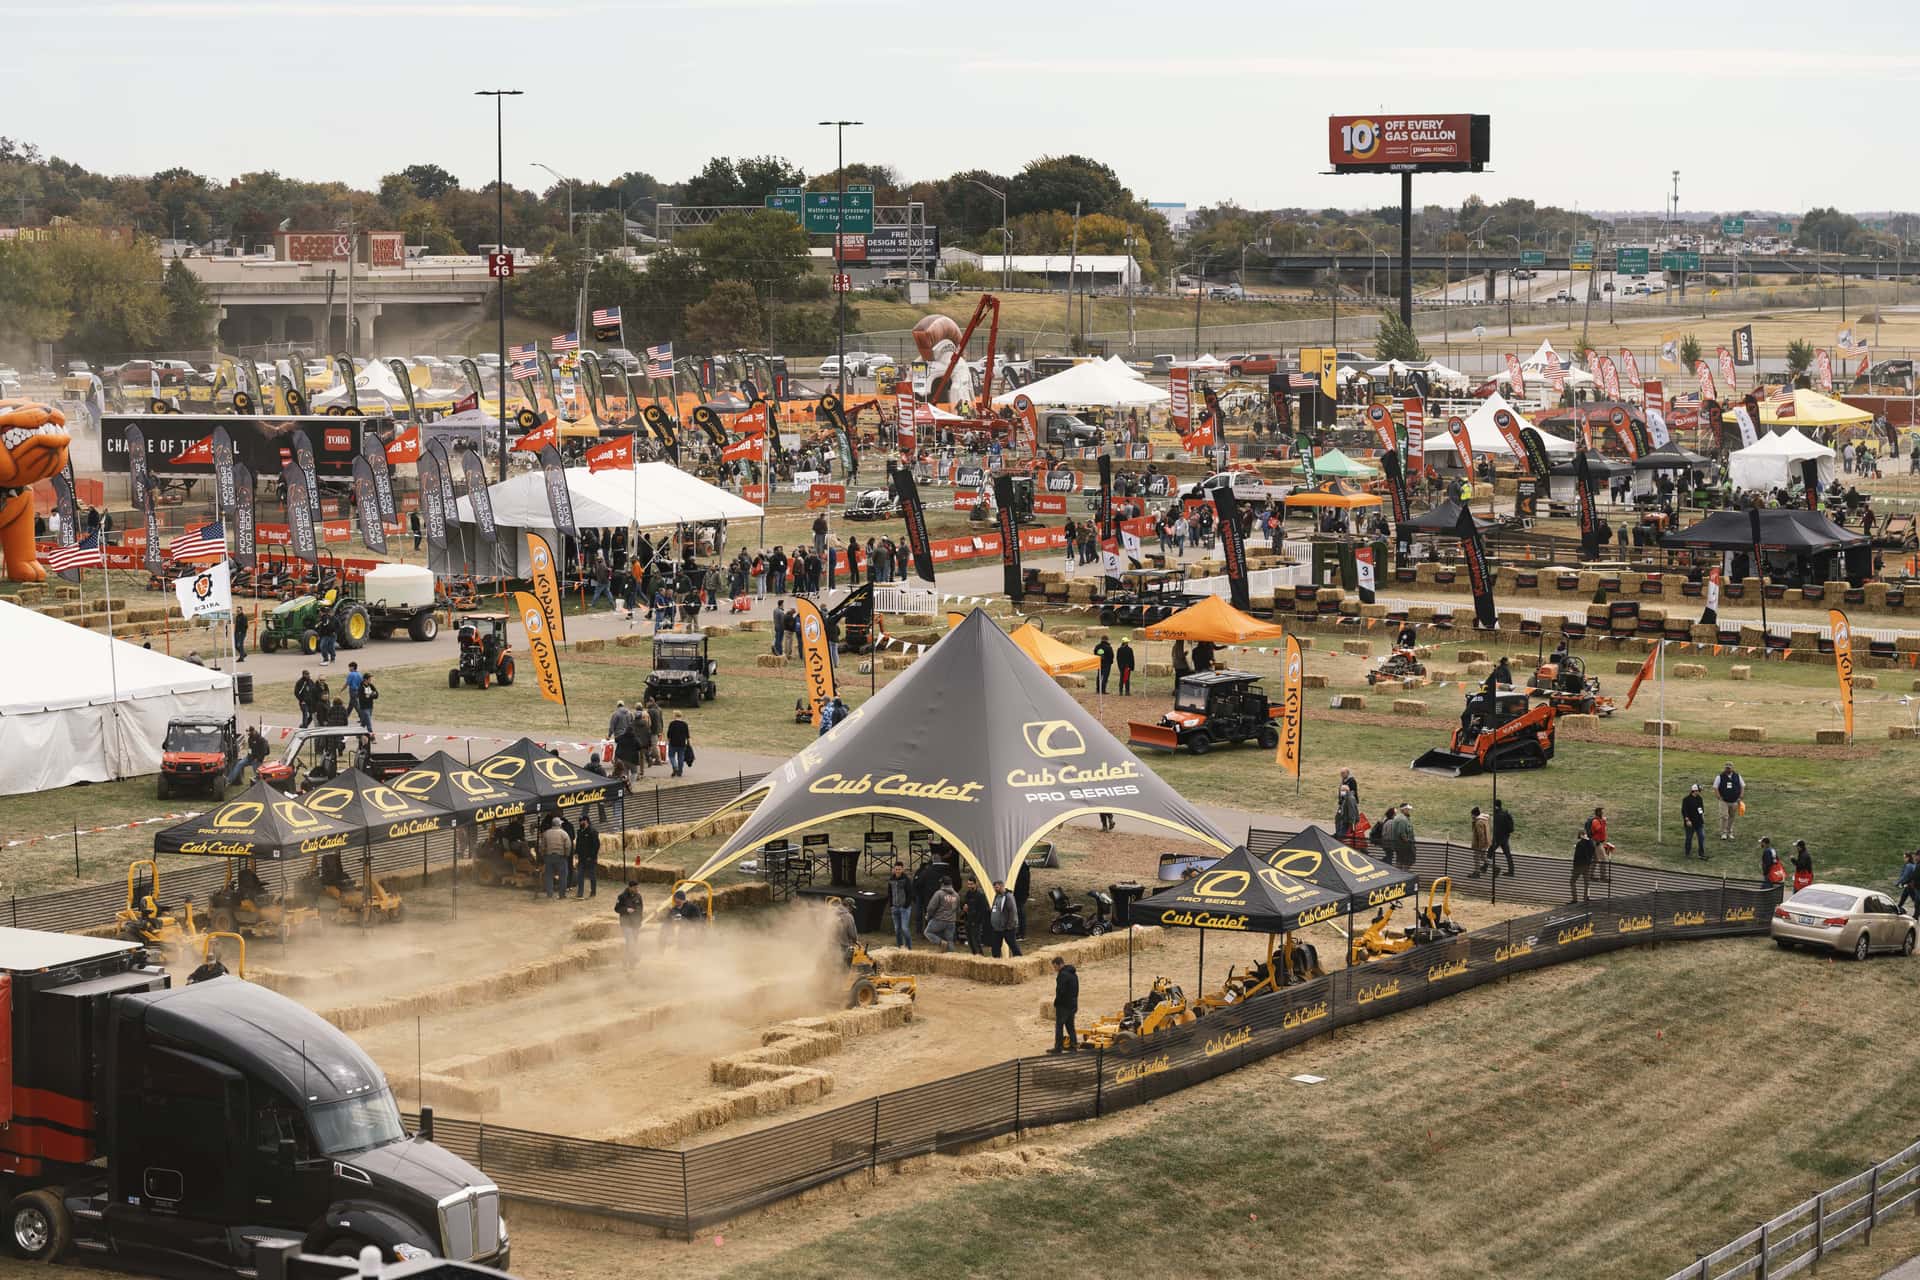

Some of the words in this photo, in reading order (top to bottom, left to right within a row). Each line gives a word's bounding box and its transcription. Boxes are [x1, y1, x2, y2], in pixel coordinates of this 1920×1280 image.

[1385, 121, 1406, 130] OFF
[1408, 120, 1444, 129] EVERY
[1385, 132, 1408, 141] GAS
[1411, 131, 1456, 140] GALLON
[497, 255, 506, 264] C
[493, 266, 509, 276] 16
[1740, 332, 1749, 361] CASE
[107, 438, 154, 452] CHAE
[160, 439, 175, 452] OF
[327, 436, 349, 444] TORO
[1222, 520, 1239, 579] Kawasaki
[1233, 532, 1244, 563] ENGINES
[1109, 556, 1115, 566] 2
[1362, 566, 1369, 576] 3
[1007, 769, 1057, 787] Cub
[1058, 761, 1141, 784] Cadet
[557, 795, 575, 808] Cub
[576, 789, 606, 803] Cadet
[809, 773, 872, 794] Cub
[873, 774, 984, 803] Cadet
[1025, 791, 1065, 803] PRO
[1070, 785, 1140, 800] SERIES
[475, 808, 495, 822] Cub
[495, 801, 525, 817] Cadet
[389, 823, 408, 838] Cub
[408, 817, 440, 833] Cadet
[179, 841, 207, 855] Cub
[208, 841, 255, 855] Cadet
[300, 839, 317, 853] Cub
[318, 832, 349, 849] Cadet
[1205, 897, 1246, 906] SERIES
[1368, 891, 1384, 905] Cub
[1384, 883, 1406, 901] Cadet
[1161, 910, 1193, 925] Cub
[1193, 911, 1249, 930] Cadet
[1297, 911, 1314, 927] Cub
[1313, 902, 1339, 921] Cadet
[1558, 931, 1572, 945] Cub
[1572, 922, 1594, 941] Cadet
[1428, 966, 1444, 982] Cub
[1444, 959, 1468, 977] Cadet
[1358, 989, 1374, 1005] Cub
[1374, 978, 1400, 999] Cadet
[1283, 1011, 1301, 1029] Cub
[1300, 1001, 1329, 1024] Cadet
[1204, 1039, 1224, 1056] Cub
[1224, 1025, 1254, 1049] Cadet
[1116, 1066, 1136, 1084] Cub
[1136, 1055, 1169, 1078] Cadet
